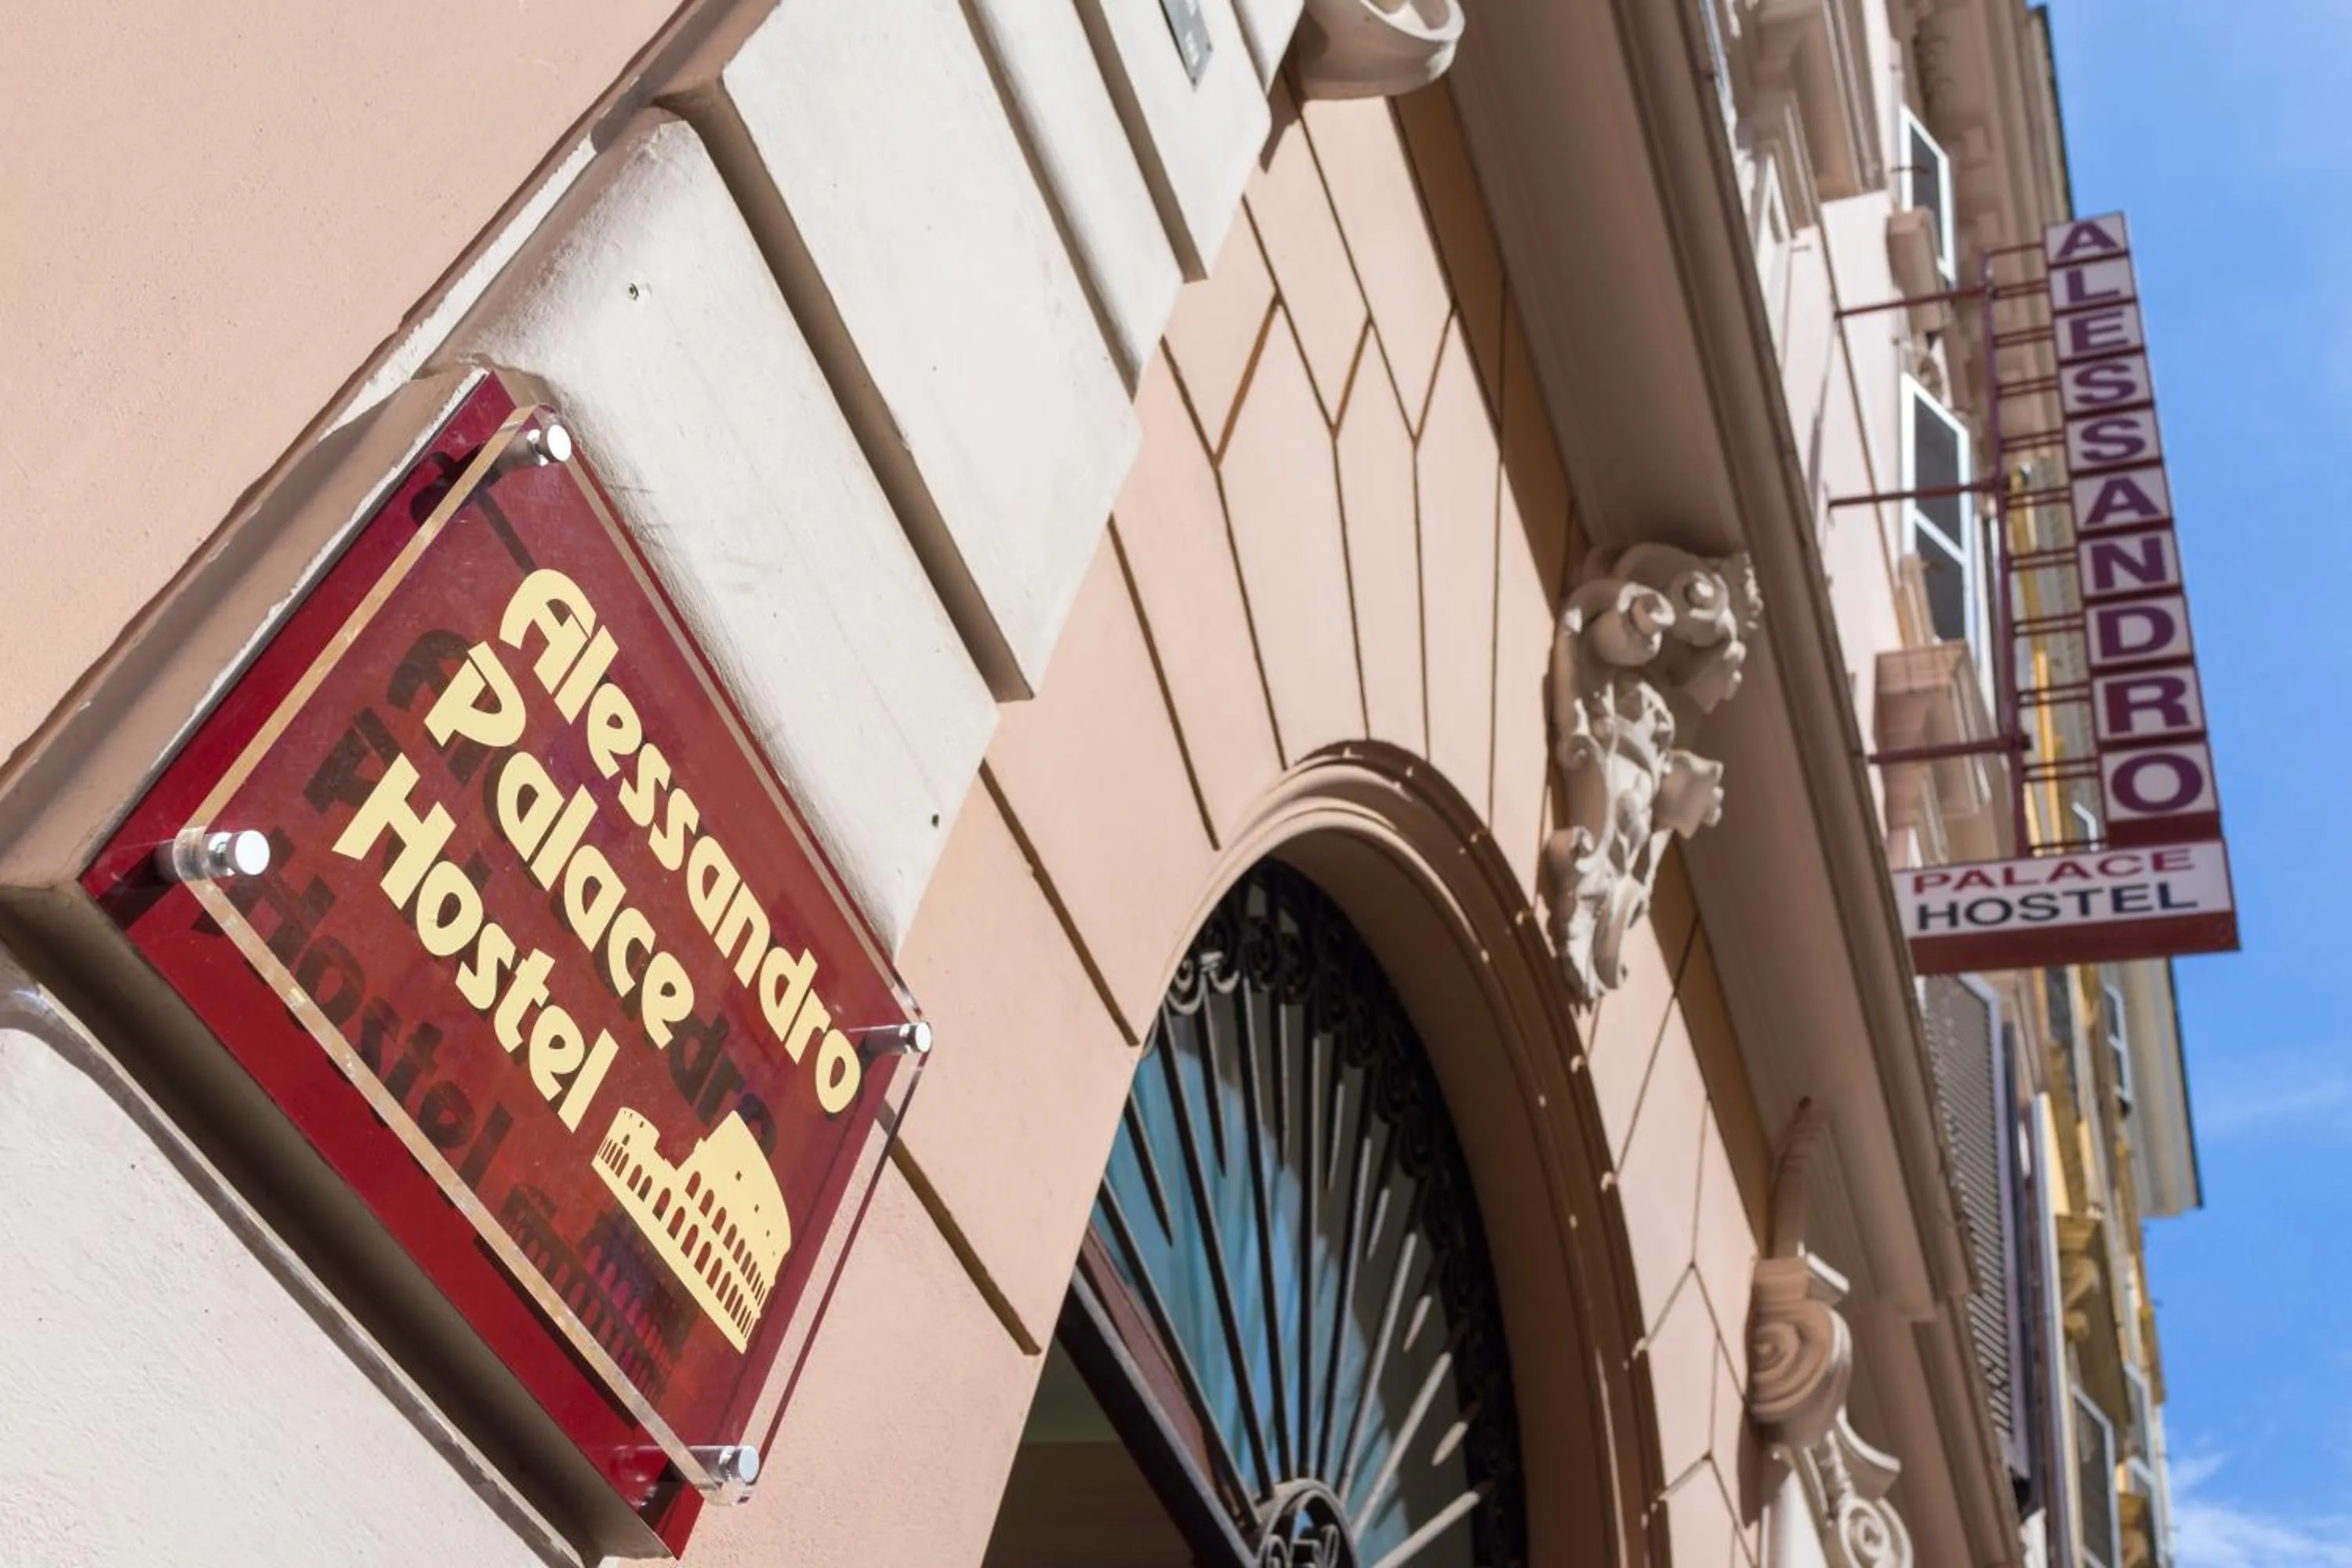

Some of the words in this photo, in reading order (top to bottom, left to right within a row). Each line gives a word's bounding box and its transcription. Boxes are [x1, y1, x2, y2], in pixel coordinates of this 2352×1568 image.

[2055, 220, 2205, 813] ALESSANDRO
[332, 752, 619, 1133] Hostel
[424, 641, 695, 1050] Palace
[499, 569, 861, 1113] Alessandro
[1912, 848, 2195, 895] PALACE
[1918, 881, 2198, 931] HOSTEL
